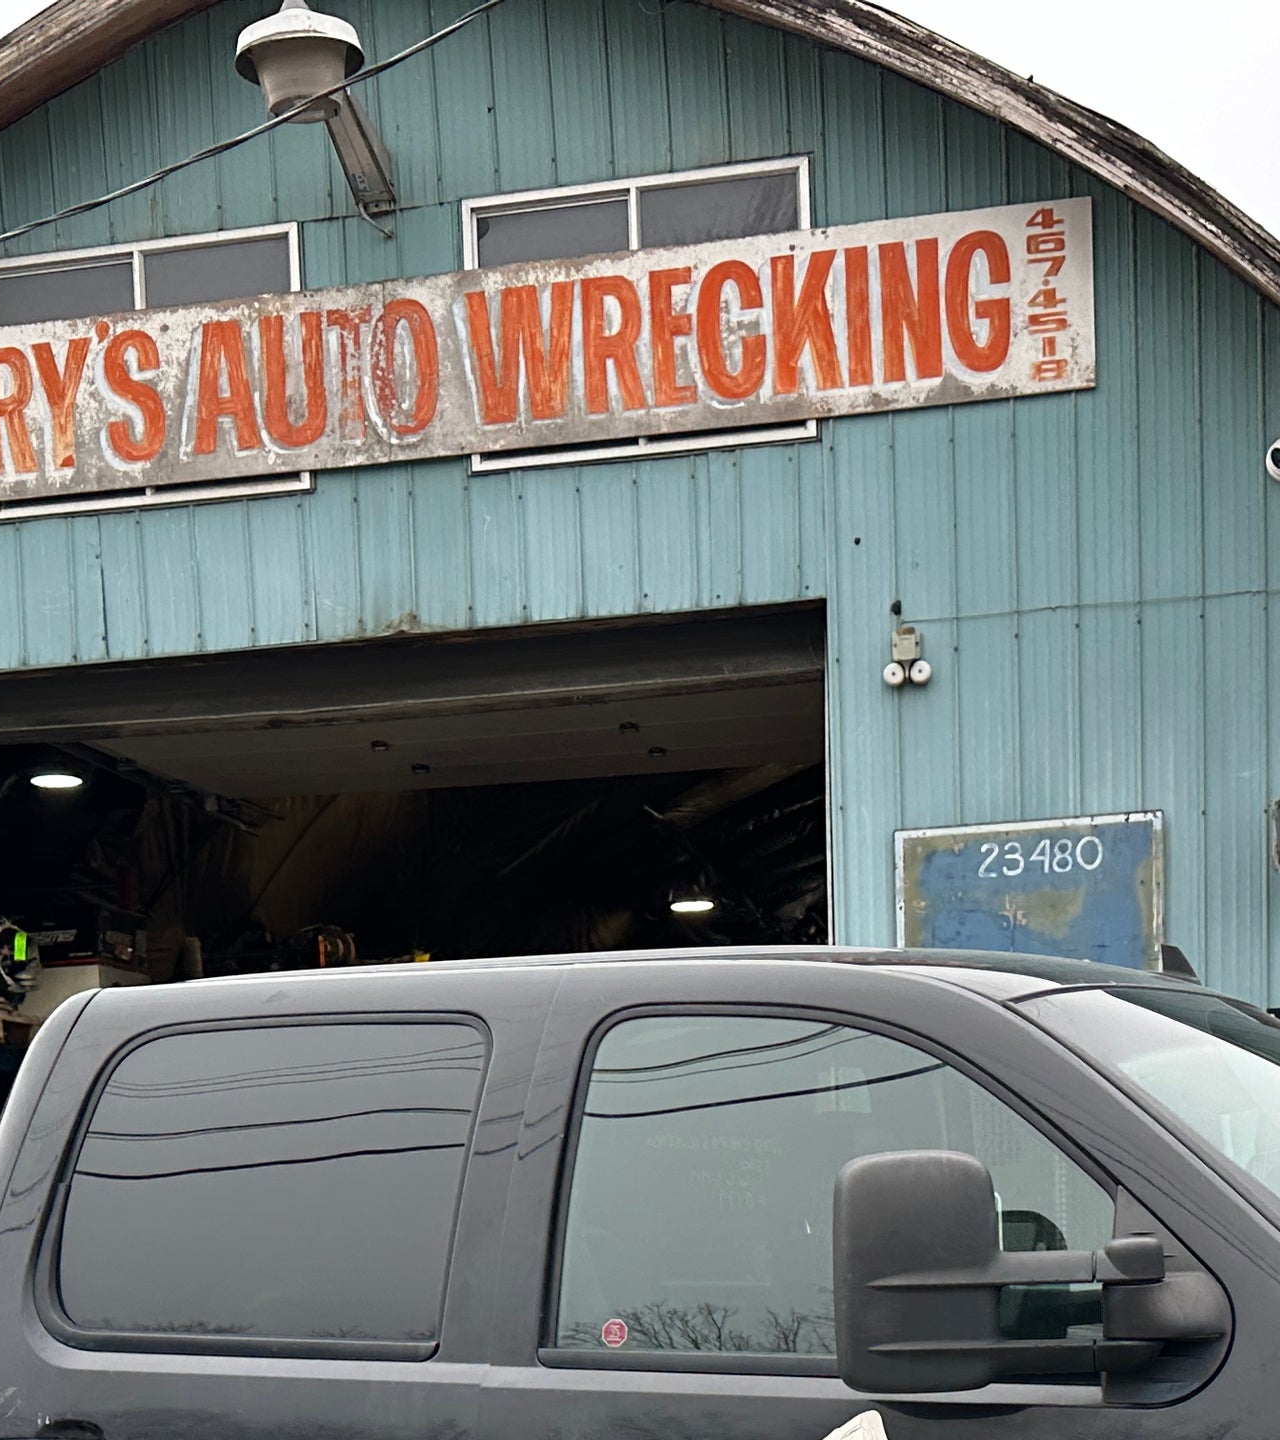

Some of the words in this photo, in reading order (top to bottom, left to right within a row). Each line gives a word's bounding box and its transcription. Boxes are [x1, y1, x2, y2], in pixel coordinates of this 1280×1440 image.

[193, 297, 439, 456] AUTO
[464, 229, 1012, 426] WRECKING
[977, 834, 1104, 878] 23480
